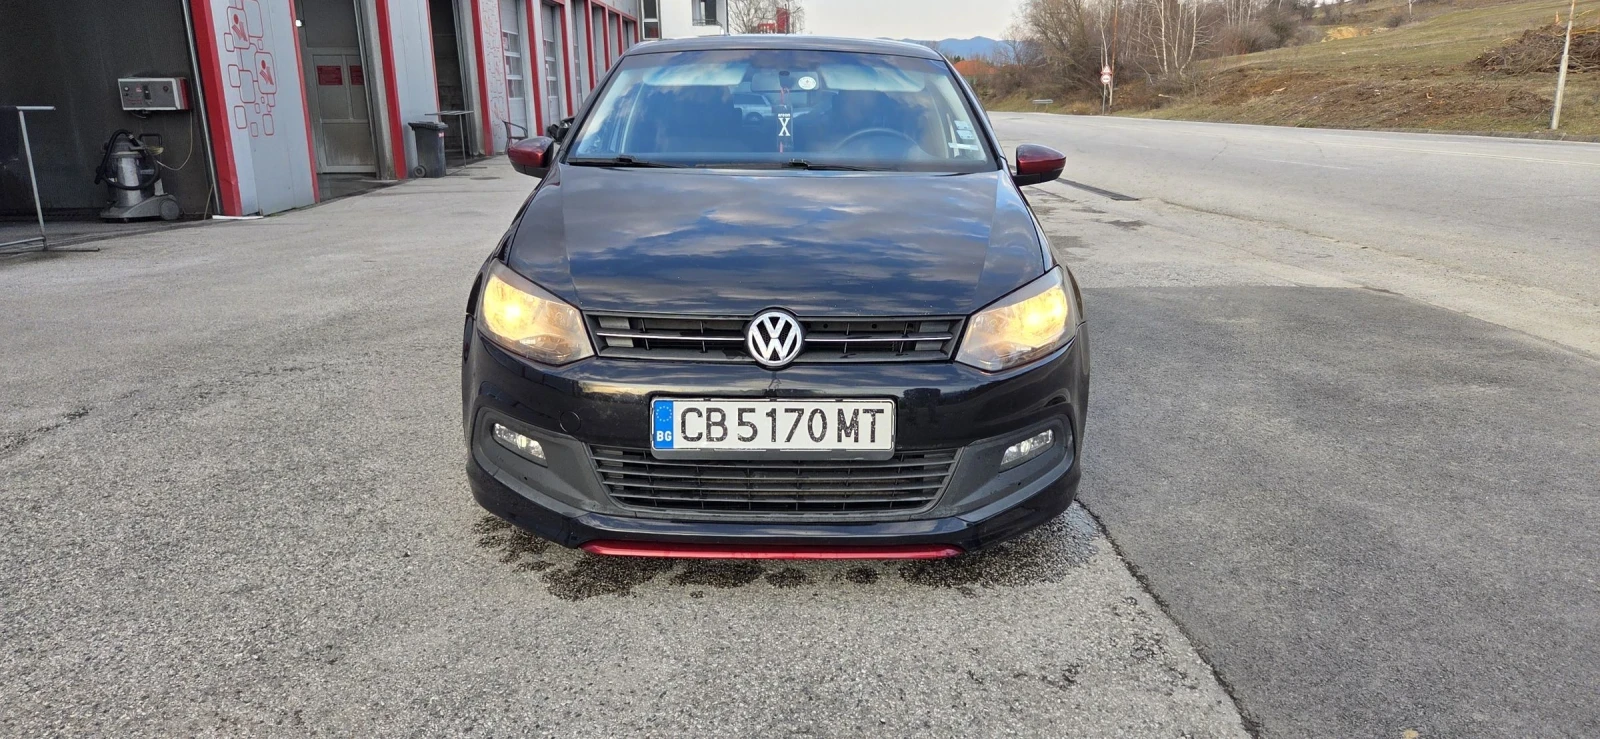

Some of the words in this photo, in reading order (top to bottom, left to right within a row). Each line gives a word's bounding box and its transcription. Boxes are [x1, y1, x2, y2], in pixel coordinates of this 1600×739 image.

[778, 118, 791, 136] X
[749, 312, 801, 364] VW
[656, 431, 672, 442] BG
[680, 407, 728, 442] CB
[737, 407, 828, 443] 5170
[836, 408, 885, 443] MT
